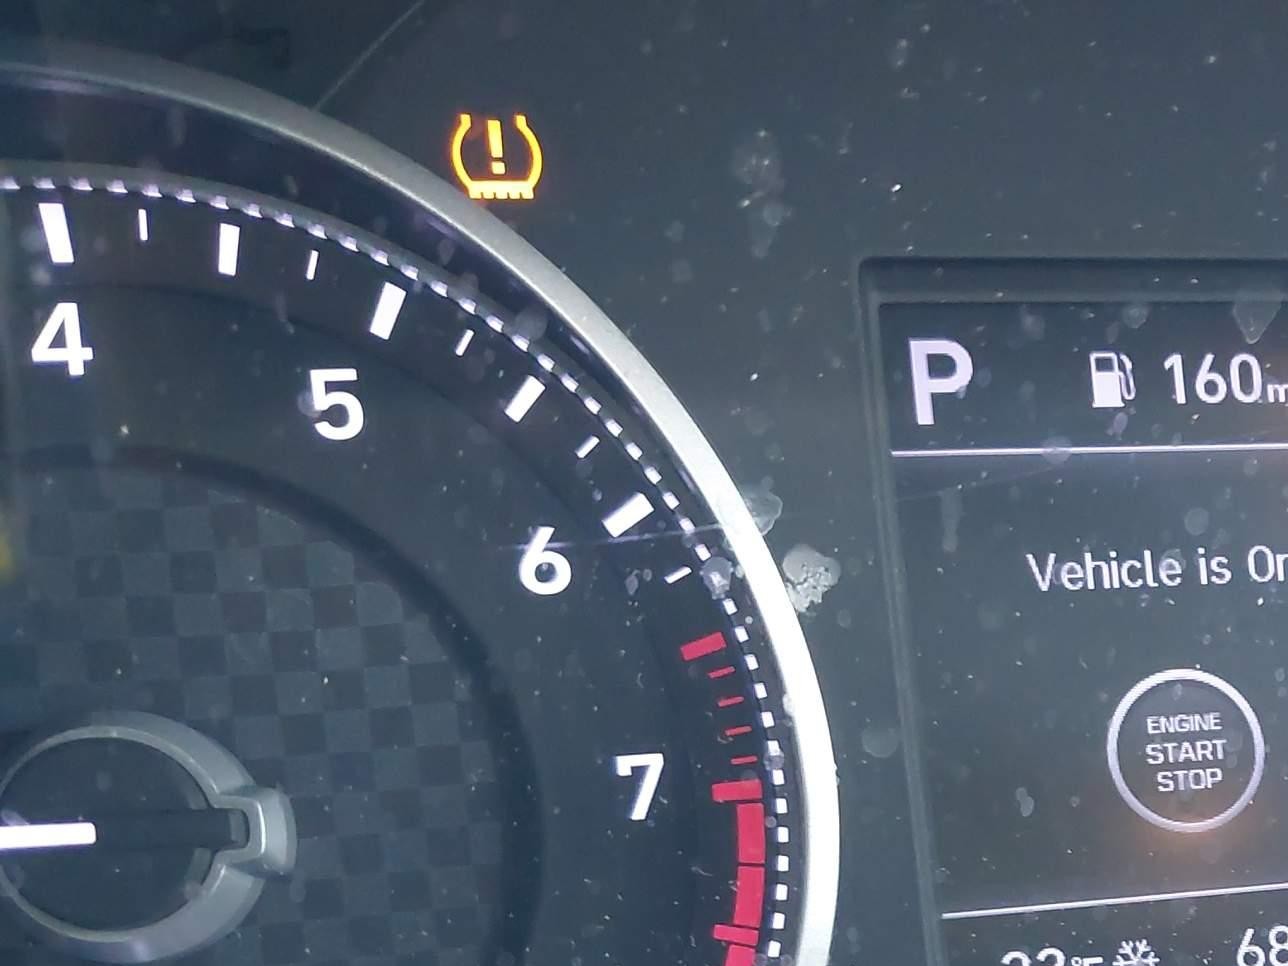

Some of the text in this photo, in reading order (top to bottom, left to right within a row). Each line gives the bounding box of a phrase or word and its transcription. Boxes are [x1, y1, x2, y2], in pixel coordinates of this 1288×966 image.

[31, 302, 93, 376] 4
[308, 368, 364, 441] 5
[908, 337, 973, 425] P
[518, 527, 572, 596] 6
[1025, 548, 1183, 591] Vehicle
[1199, 548, 1232, 585] is
[1145, 739, 1227, 765] START
[1146, 711, 1222, 735] ENGINE
[615, 752, 665, 821] 7
[1157, 768, 1223, 793] STOP
